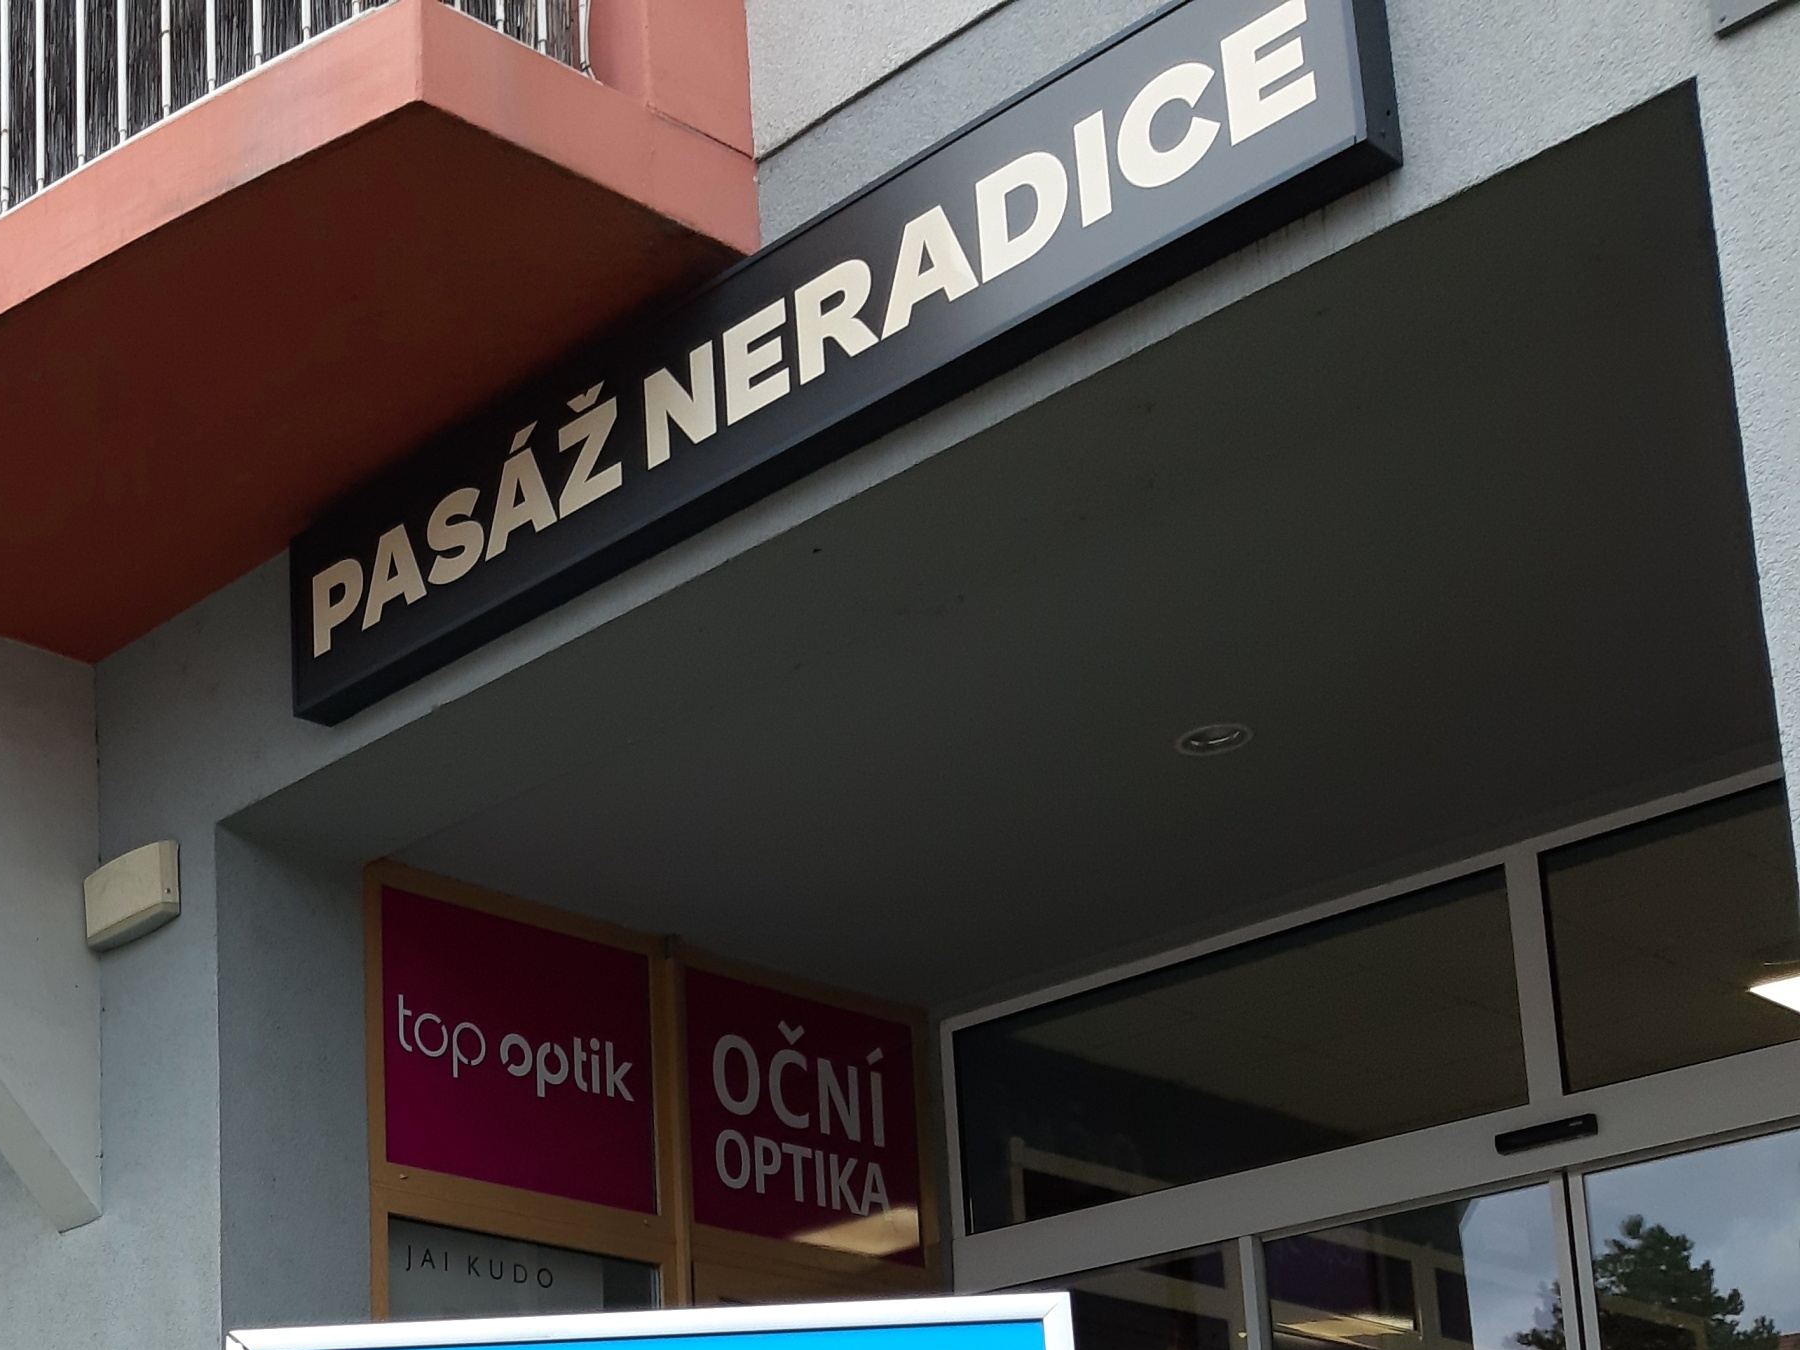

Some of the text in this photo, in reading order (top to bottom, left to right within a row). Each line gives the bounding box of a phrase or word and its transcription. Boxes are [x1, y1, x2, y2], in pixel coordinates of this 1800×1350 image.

[311, 0, 1318, 660] PASÁŽ NERADICE
[397, 994, 635, 1102] top optik
[712, 1020, 886, 1148] OČNÍ
[715, 1128, 892, 1220] OPTIKA
[406, 1244, 556, 1289] JAI KUDO
